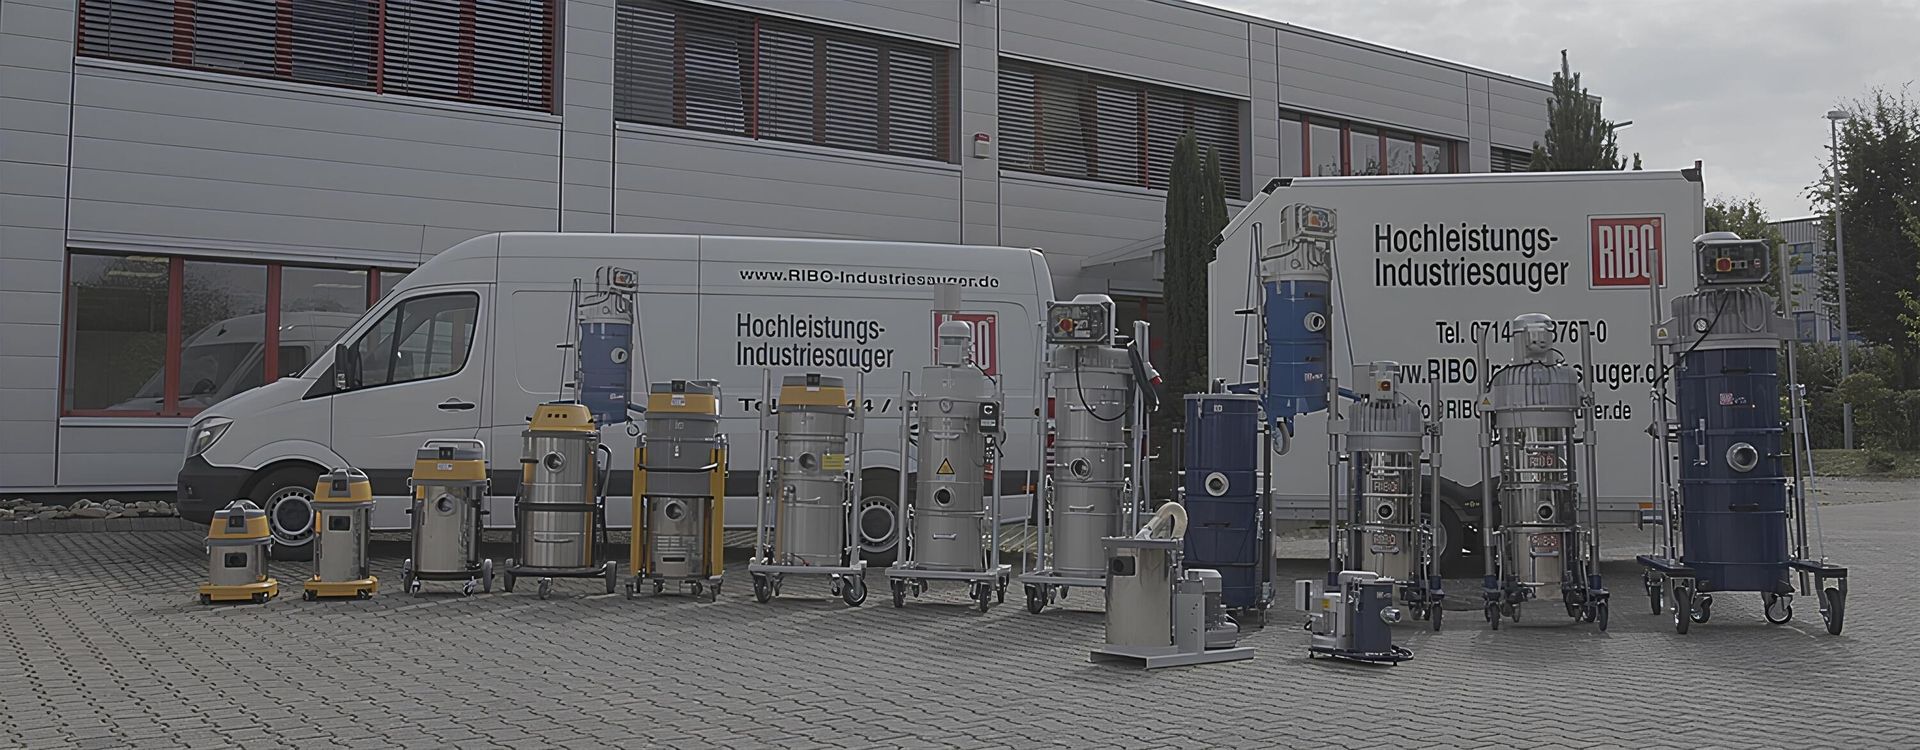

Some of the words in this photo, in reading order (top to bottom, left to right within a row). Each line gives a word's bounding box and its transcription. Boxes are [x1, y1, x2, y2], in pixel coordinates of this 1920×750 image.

[1375, 223, 1559, 258] Hochleistungs-
[1598, 224, 1655, 279] RIBO
[1375, 257, 1569, 292] Industriesauger
[737, 313, 885, 344] Hochleistungs-
[1436, 320, 1465, 344] Tel.
[737, 341, 894, 373] Industriesauger
